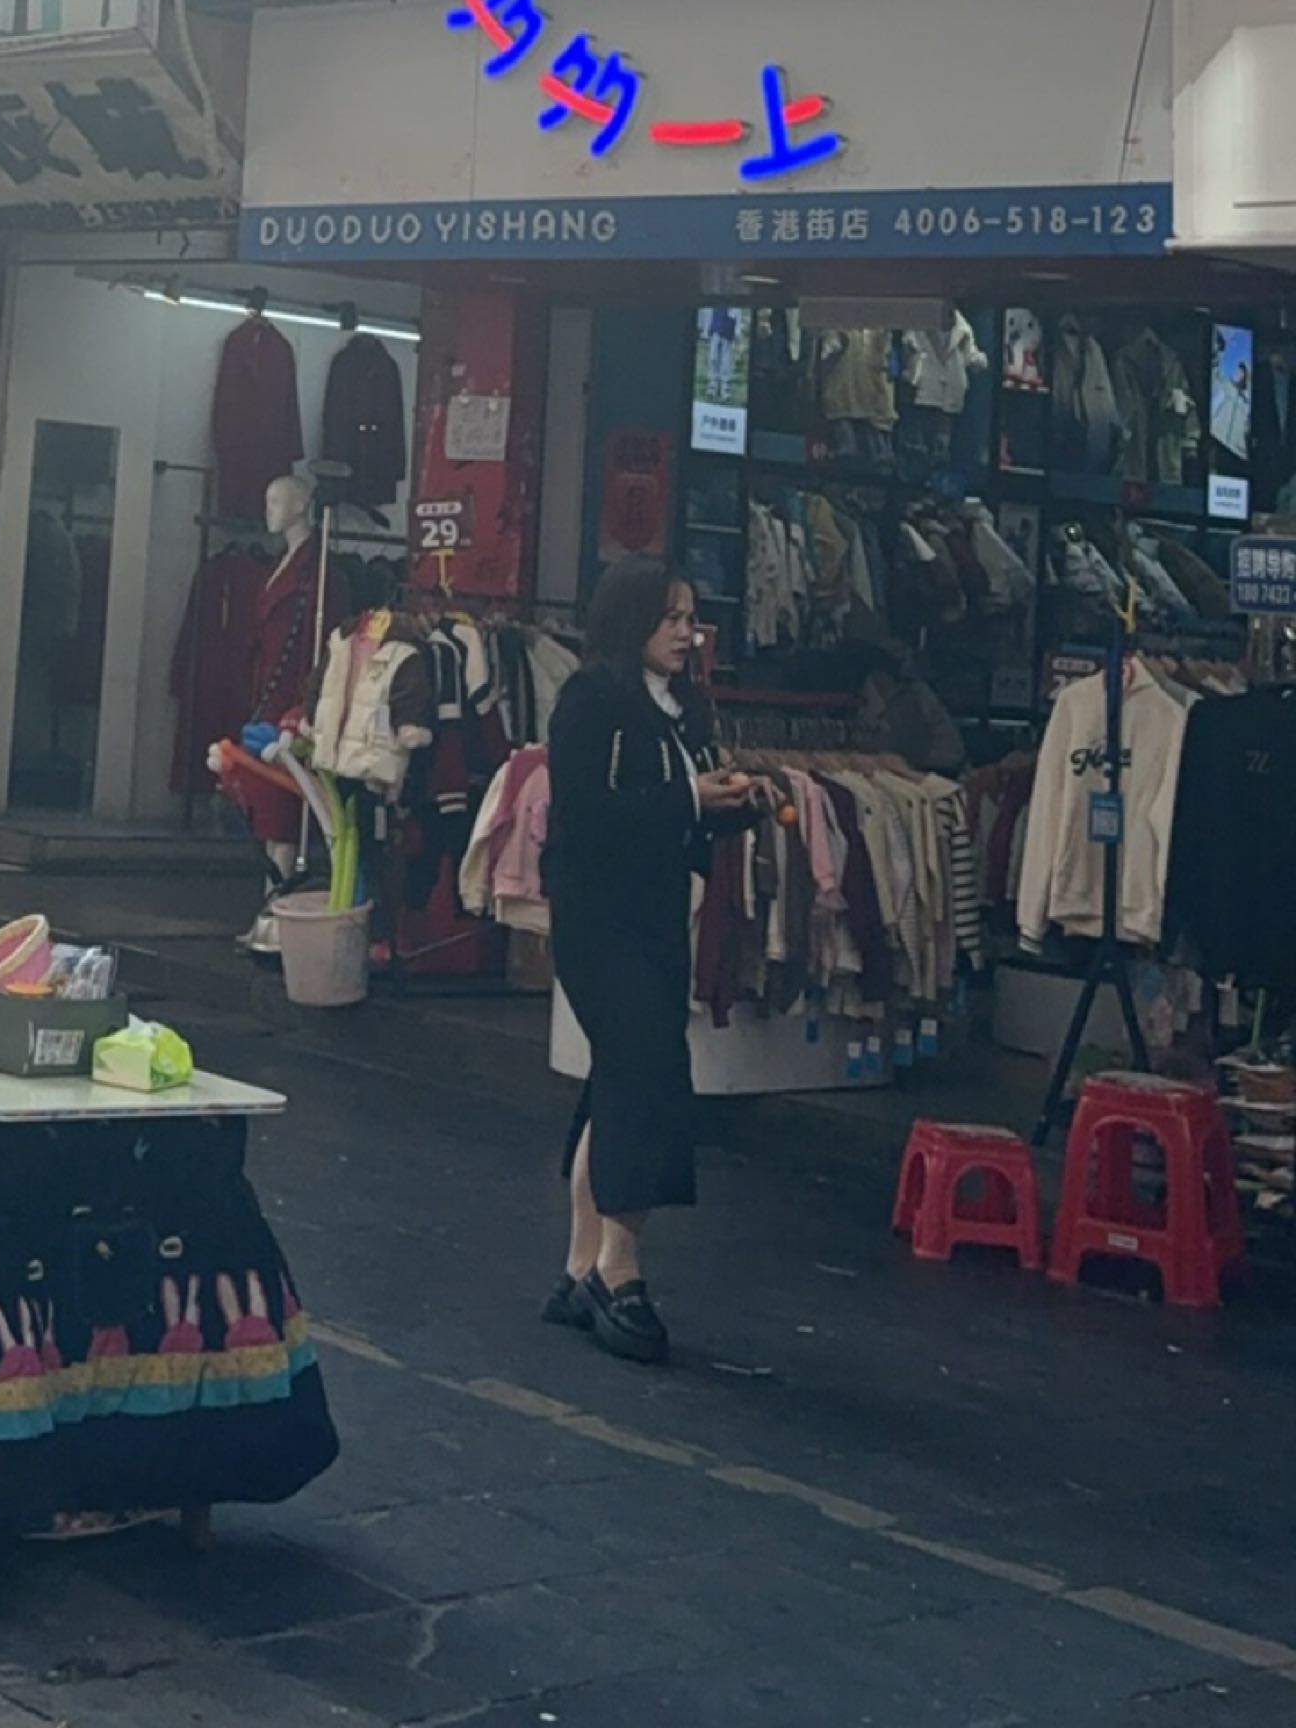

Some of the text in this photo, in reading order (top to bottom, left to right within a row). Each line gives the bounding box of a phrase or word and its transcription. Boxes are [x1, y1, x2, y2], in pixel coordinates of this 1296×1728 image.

[259, 212, 421, 247] DUODUO
[435, 207, 618, 243] YISHANG
[735, 203, 1157, 243] 香港街店 4006-518-123
[421, 519, 458, 548] 29
